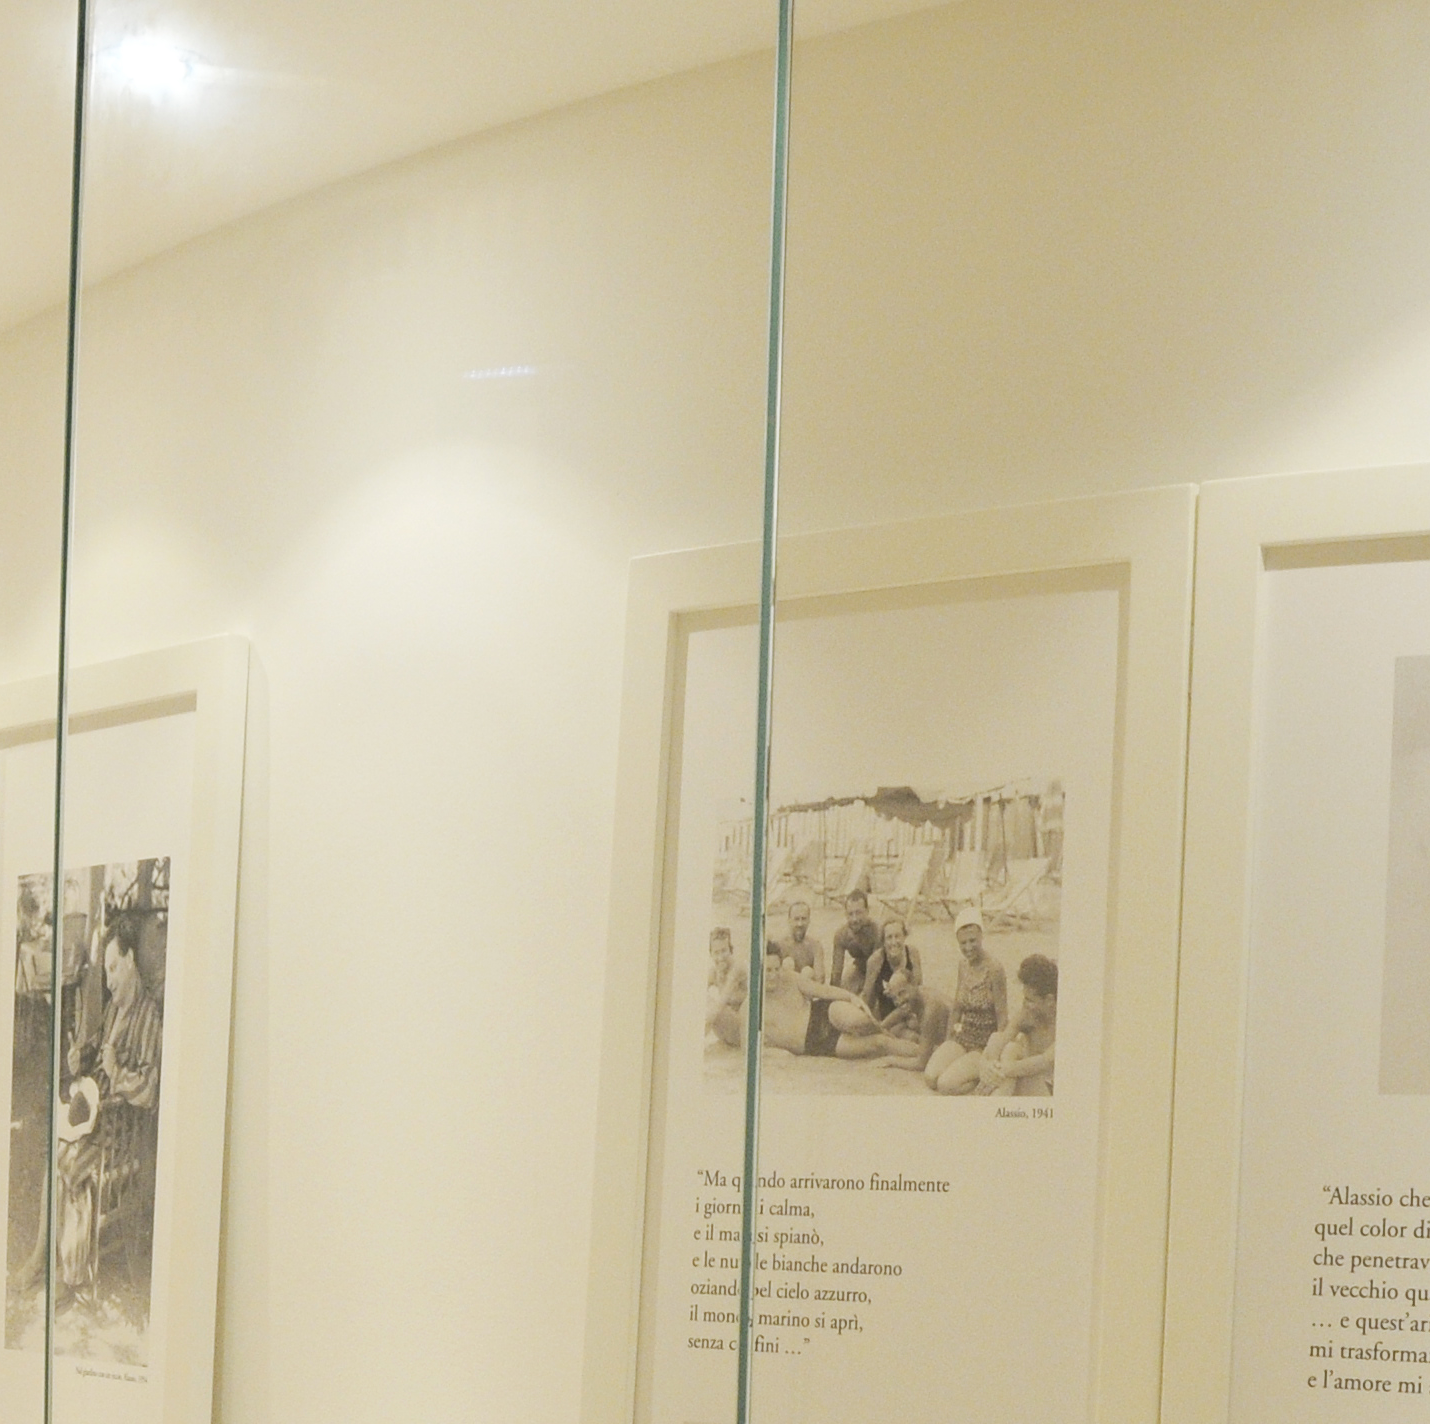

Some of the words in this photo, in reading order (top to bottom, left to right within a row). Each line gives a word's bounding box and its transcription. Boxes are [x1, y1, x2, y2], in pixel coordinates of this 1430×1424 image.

[995, 1107, 1028, 1119] Alassio,
[1033, 1108, 1053, 1118] 1941
[732, 1170, 785, 1193] qndo
[790, 1172, 865, 1190] arrivarono
[870, 1173, 950, 1193] finalmente
[1399, 1188, 1430, 1208] che
[1314, 1218, 1353, 1241] quel
[1360, 1218, 1407, 1238] color
[1413, 1219, 1430, 1239] di
[692, 1257, 700, 1267] e
[704, 1251, 715, 1268] le
[720, 1252, 768, 1272] nule
[773, 1254, 827, 1273] bianche
[832, 1257, 902, 1276] andarono
[1313, 1247, 1344, 1266] che
[690, 1280, 742, 1298] oziand
[776, 1282, 809, 1299] cielo
[814, 1290, 871, 1304] azzurro,
[1313, 1277, 1323, 1296] il
[1330, 1279, 1398, 1299] vecchio
[1340, 1317, 1349, 1328] e
[688, 1338, 724, 1350] senza
[729, 1334, 780, 1355] cfini
[1310, 1342, 1332, 1358] mi
[1307, 1376, 1317, 1388] e
[1398, 1376, 1422, 1394] mi
